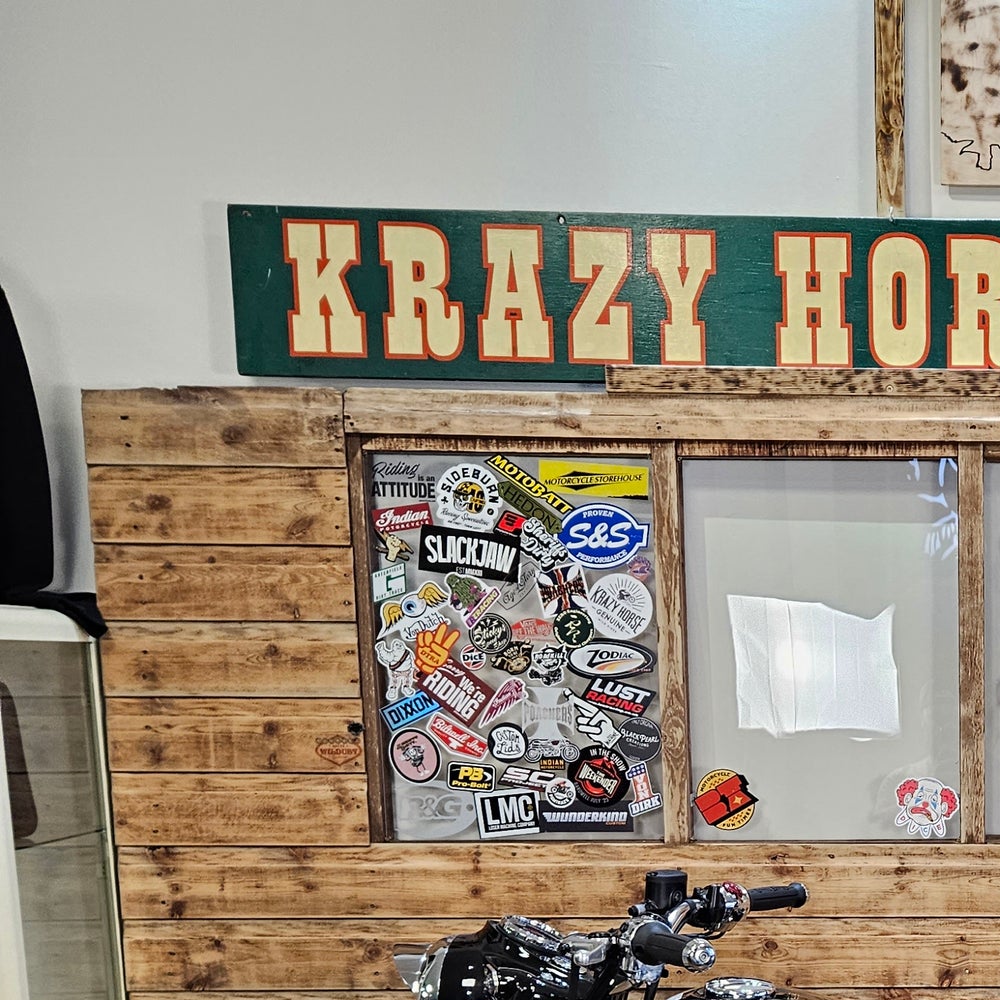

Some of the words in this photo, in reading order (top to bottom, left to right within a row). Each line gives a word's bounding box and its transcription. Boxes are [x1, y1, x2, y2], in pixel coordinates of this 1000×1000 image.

[282, 219, 716, 366] KRAZY
[372, 461, 420, 479] Riding
[544, 476, 594, 487] MOTORCYCLE
[593, 473, 643, 484] STOREHOUSE
[371, 481, 436, 499] ATTITUDE
[441, 468, 500, 504] SIDEBURN
[490, 454, 574, 514] MOTOBATT
[376, 509, 429, 527] Indian
[504, 486, 556, 530] HEDON
[582, 510, 614, 518] PROVEN
[379, 520, 429, 532] MOTORCYCLE
[566, 522, 633, 549] S&S
[425, 535, 517, 574] SLACKJAW
[576, 549, 628, 564] PERFORMANCE
[590, 586, 618, 612] KRAZY
[617, 603, 646, 634] HORSE
[596, 610, 626, 632] GENUINE
[586, 649, 634, 669] ZODIAC
[422, 670, 480, 720] RIDING
[459, 676, 486, 703] We're
[590, 679, 651, 703] LUST
[387, 693, 435, 725] DIXXON
[586, 690, 645, 714] RACING
[432, 718, 467, 743] Biltwell
[590, 748, 598, 756] IN
[599, 748, 612, 759] THE
[611, 752, 627, 772] SHOW
[452, 780, 491, 789] Pro-Bolt
[458, 766, 484, 782] PB
[503, 768, 555, 782] SC
[579, 762, 618, 795] WEEKENDER
[700, 772, 731, 792] MOTORCYCLE
[485, 796, 535, 826] LMC
[542, 811, 628, 823] WUNDERKIND
[631, 797, 660, 815] DIRK
